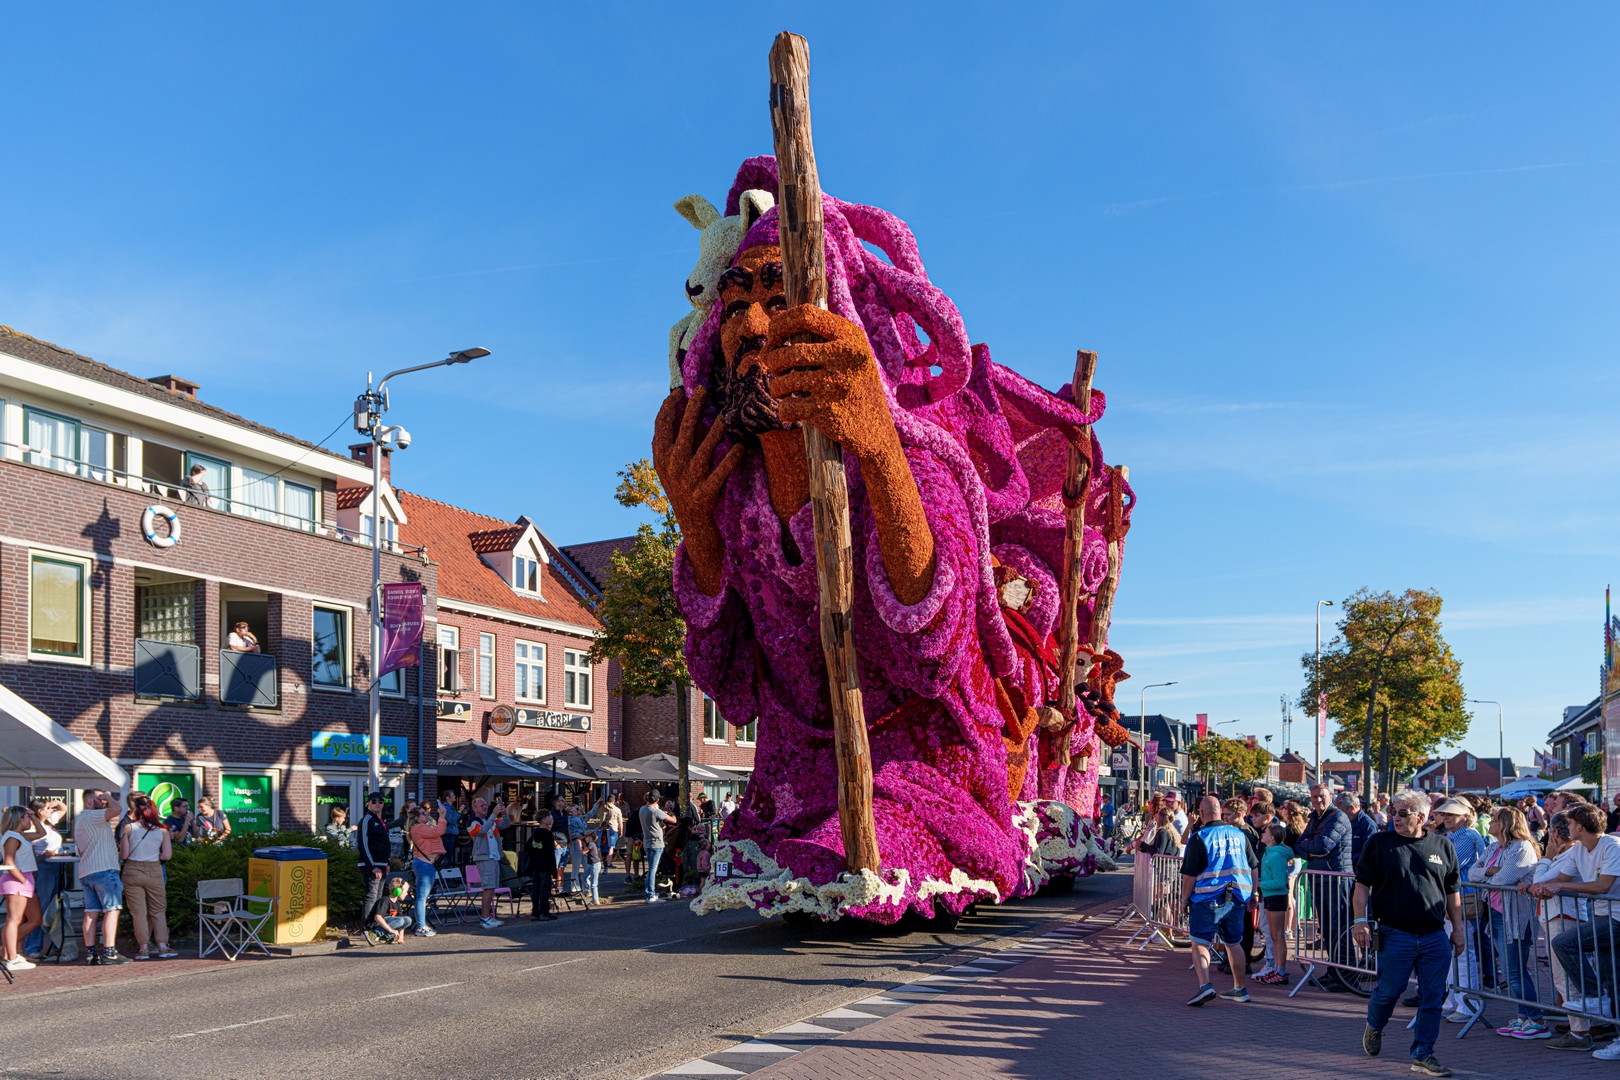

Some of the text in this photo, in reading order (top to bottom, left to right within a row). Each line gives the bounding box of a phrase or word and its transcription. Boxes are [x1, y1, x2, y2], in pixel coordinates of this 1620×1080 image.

[234, 788, 261, 796] Vastgoed
[225, 807, 270, 815] verduurzaming
[718, 864, 727, 872] 15
